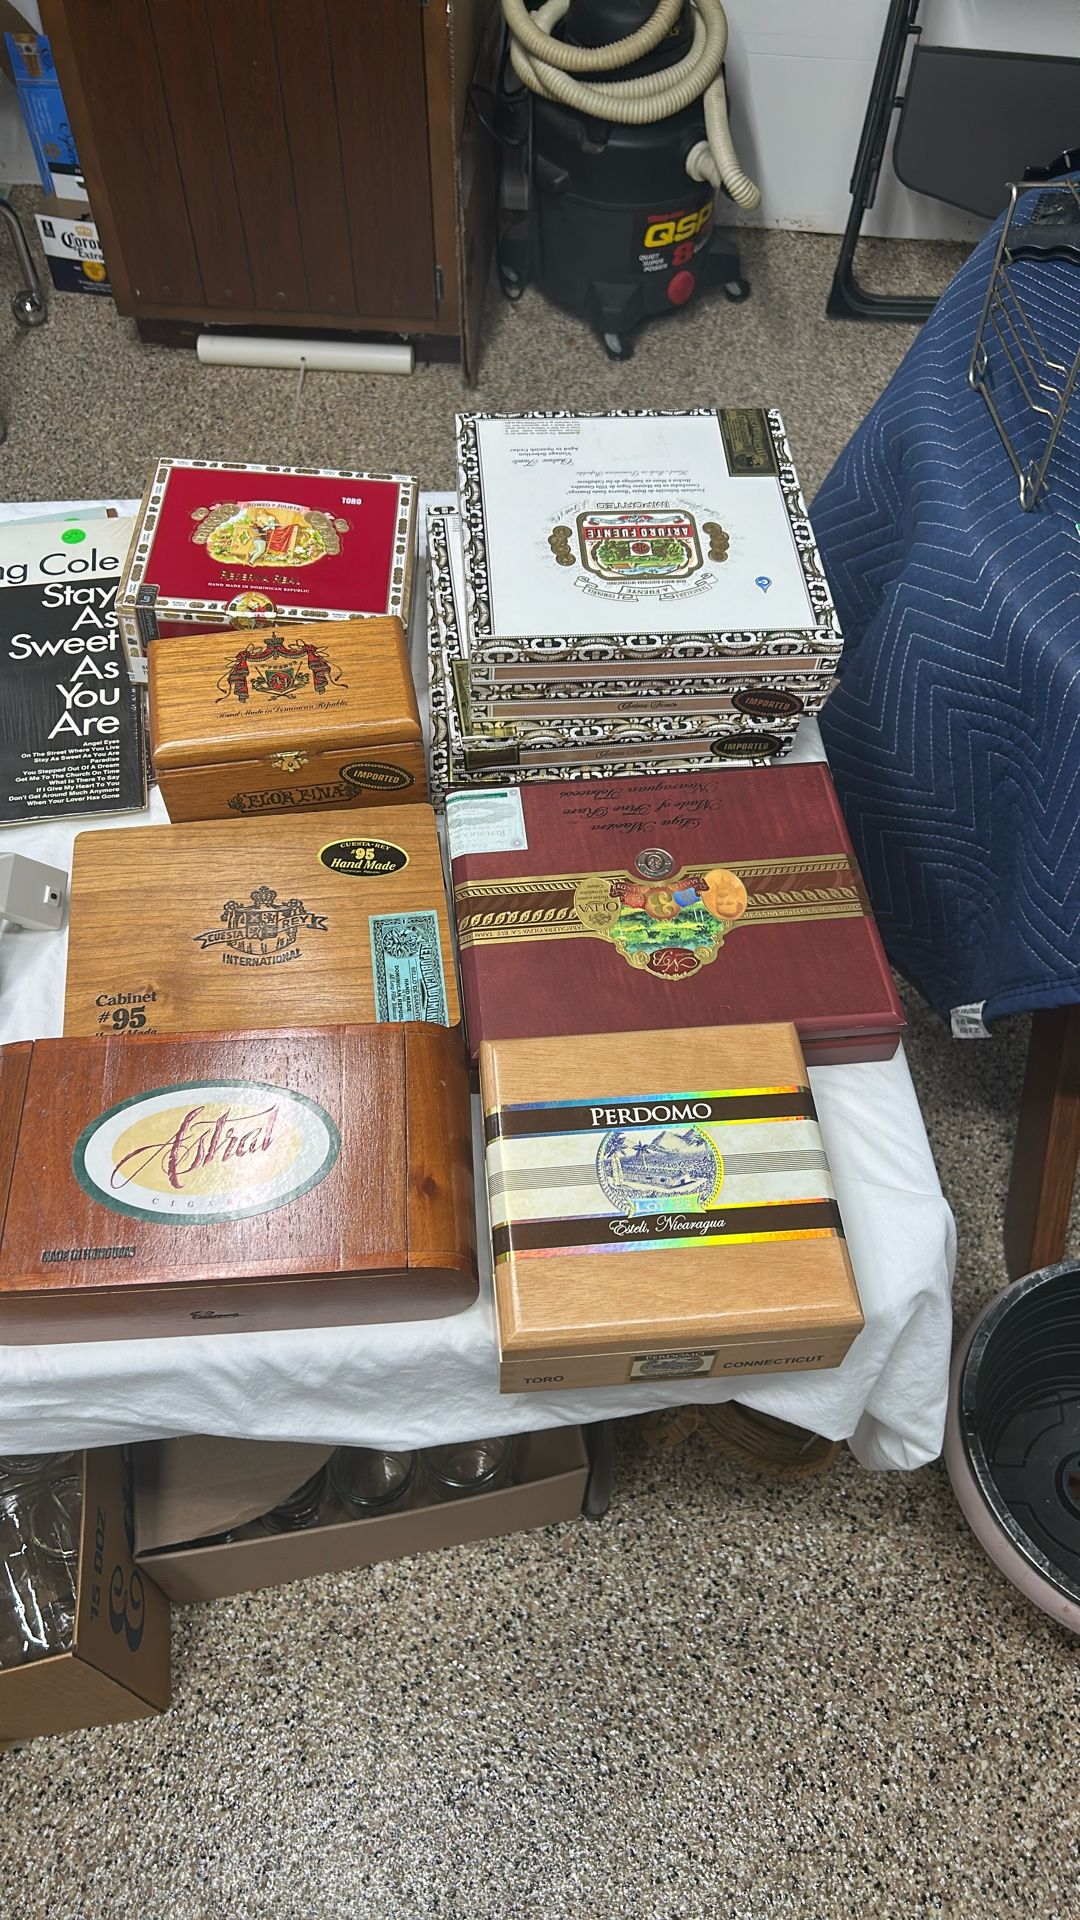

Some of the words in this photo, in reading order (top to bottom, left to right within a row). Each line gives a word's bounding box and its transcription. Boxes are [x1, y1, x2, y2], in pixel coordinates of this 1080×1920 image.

[644, 202, 713, 248] QSP
[277, 504, 301, 512] JULIETA
[341, 497, 362, 505] TORO
[596, 501, 670, 509] IMPORTED
[586, 528, 637, 539] FUENTE
[640, 527, 689, 537] ARTURO
[0, 564, 28, 584] g
[40, 548, 119, 576] Cole
[41, 583, 119, 608] Stay
[71, 605, 118, 631] As
[8, 629, 119, 660] Sweet
[70, 655, 120, 682] As
[56, 682, 120, 709] You
[745, 697, 790, 710] IMPORTED
[47, 710, 120, 739] Are
[724, 742, 769, 751] IMPORTED
[353, 769, 400, 784] IMPORTED
[559, 787, 623, 800] Tobaccos
[628, 781, 719, 795] Nicaraguan
[654, 800, 672, 813] of
[674, 799, 722, 812] Made
[340, 841, 391, 851] CUESTA-REY
[350, 848, 375, 860] #95
[331, 858, 363, 869] Hand
[363, 860, 396, 871] Made
[578, 901, 619, 913] OLIVA
[207, 930, 244, 942] CUESTA
[282, 915, 309, 928] REY
[222, 948, 302, 967] INTERNATIONAL
[420, 942, 436, 989] REPUBLICA
[394, 965, 402, 997] DOMINICAN
[95, 991, 157, 1007] Cabinet
[97, 1005, 147, 1030] #95
[590, 1102, 712, 1126] PERDOMO
[110, 1103, 280, 1189] Astral
[634, 1201, 665, 1213] LOT
[655, 1214, 726, 1235] Nicaragua
[41, 1248, 69, 1263] MADE
[645, 1350, 705, 1361] PERDOMO
[523, 1375, 564, 1384] TORO
[723, 1354, 825, 1369] CONNECTICUT
